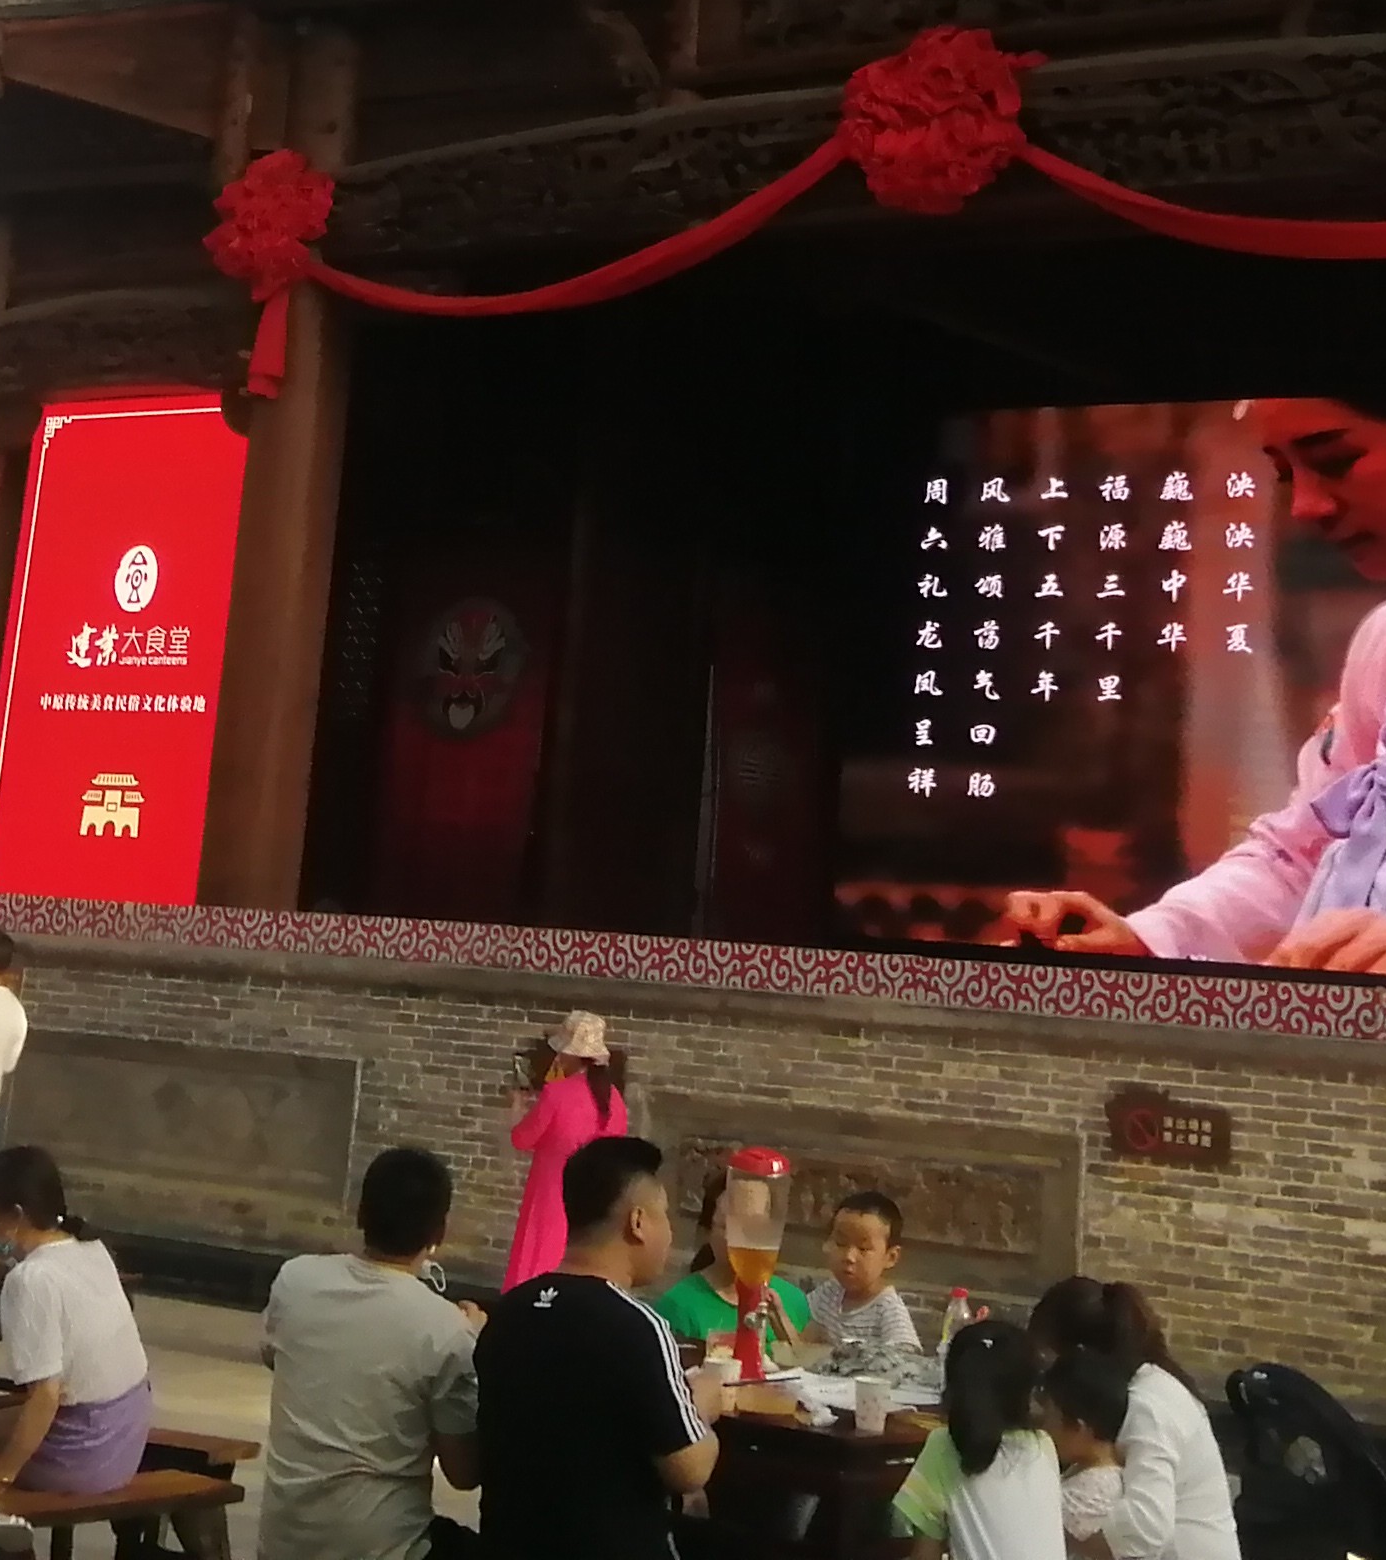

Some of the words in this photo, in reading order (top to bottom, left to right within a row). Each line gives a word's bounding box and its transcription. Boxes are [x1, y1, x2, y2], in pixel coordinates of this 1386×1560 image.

[907, 477, 949, 799] 周六礼龙凤呈祥
[967, 476, 1012, 799] 风雅颂荡气回肠
[1030, 476, 1070, 703] 上下五千年
[1095, 474, 1131, 703] 福源三千里
[1156, 471, 1195, 653] 巍巍中华
[1222, 471, 1256, 655] 泱泱华夏
[39, 692, 207, 714] 中原传统美食民俗文化体验地
